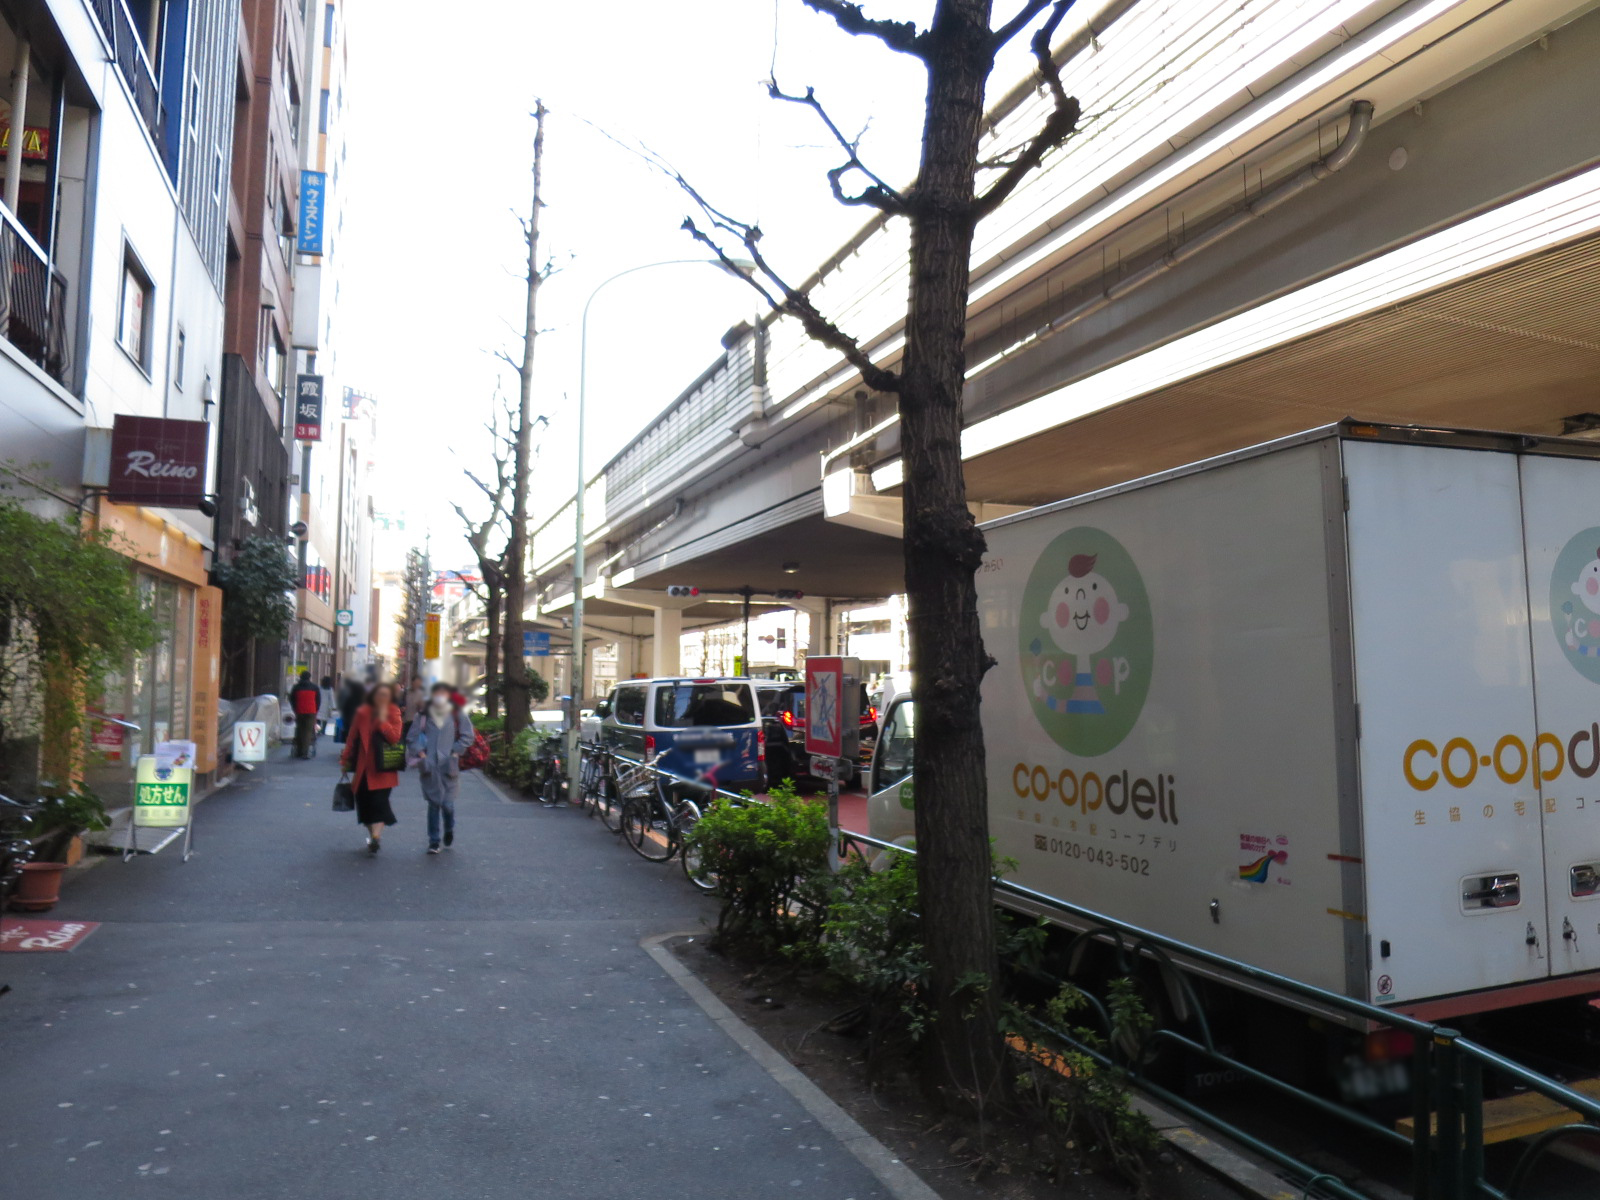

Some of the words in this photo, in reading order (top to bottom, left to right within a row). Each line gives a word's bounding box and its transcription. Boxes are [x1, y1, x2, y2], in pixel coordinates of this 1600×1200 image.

[124, 450, 198, 479] Reino
[139, 785, 185, 804] 処方せん
[1051, 838, 1150, 876] 0120-043-502
